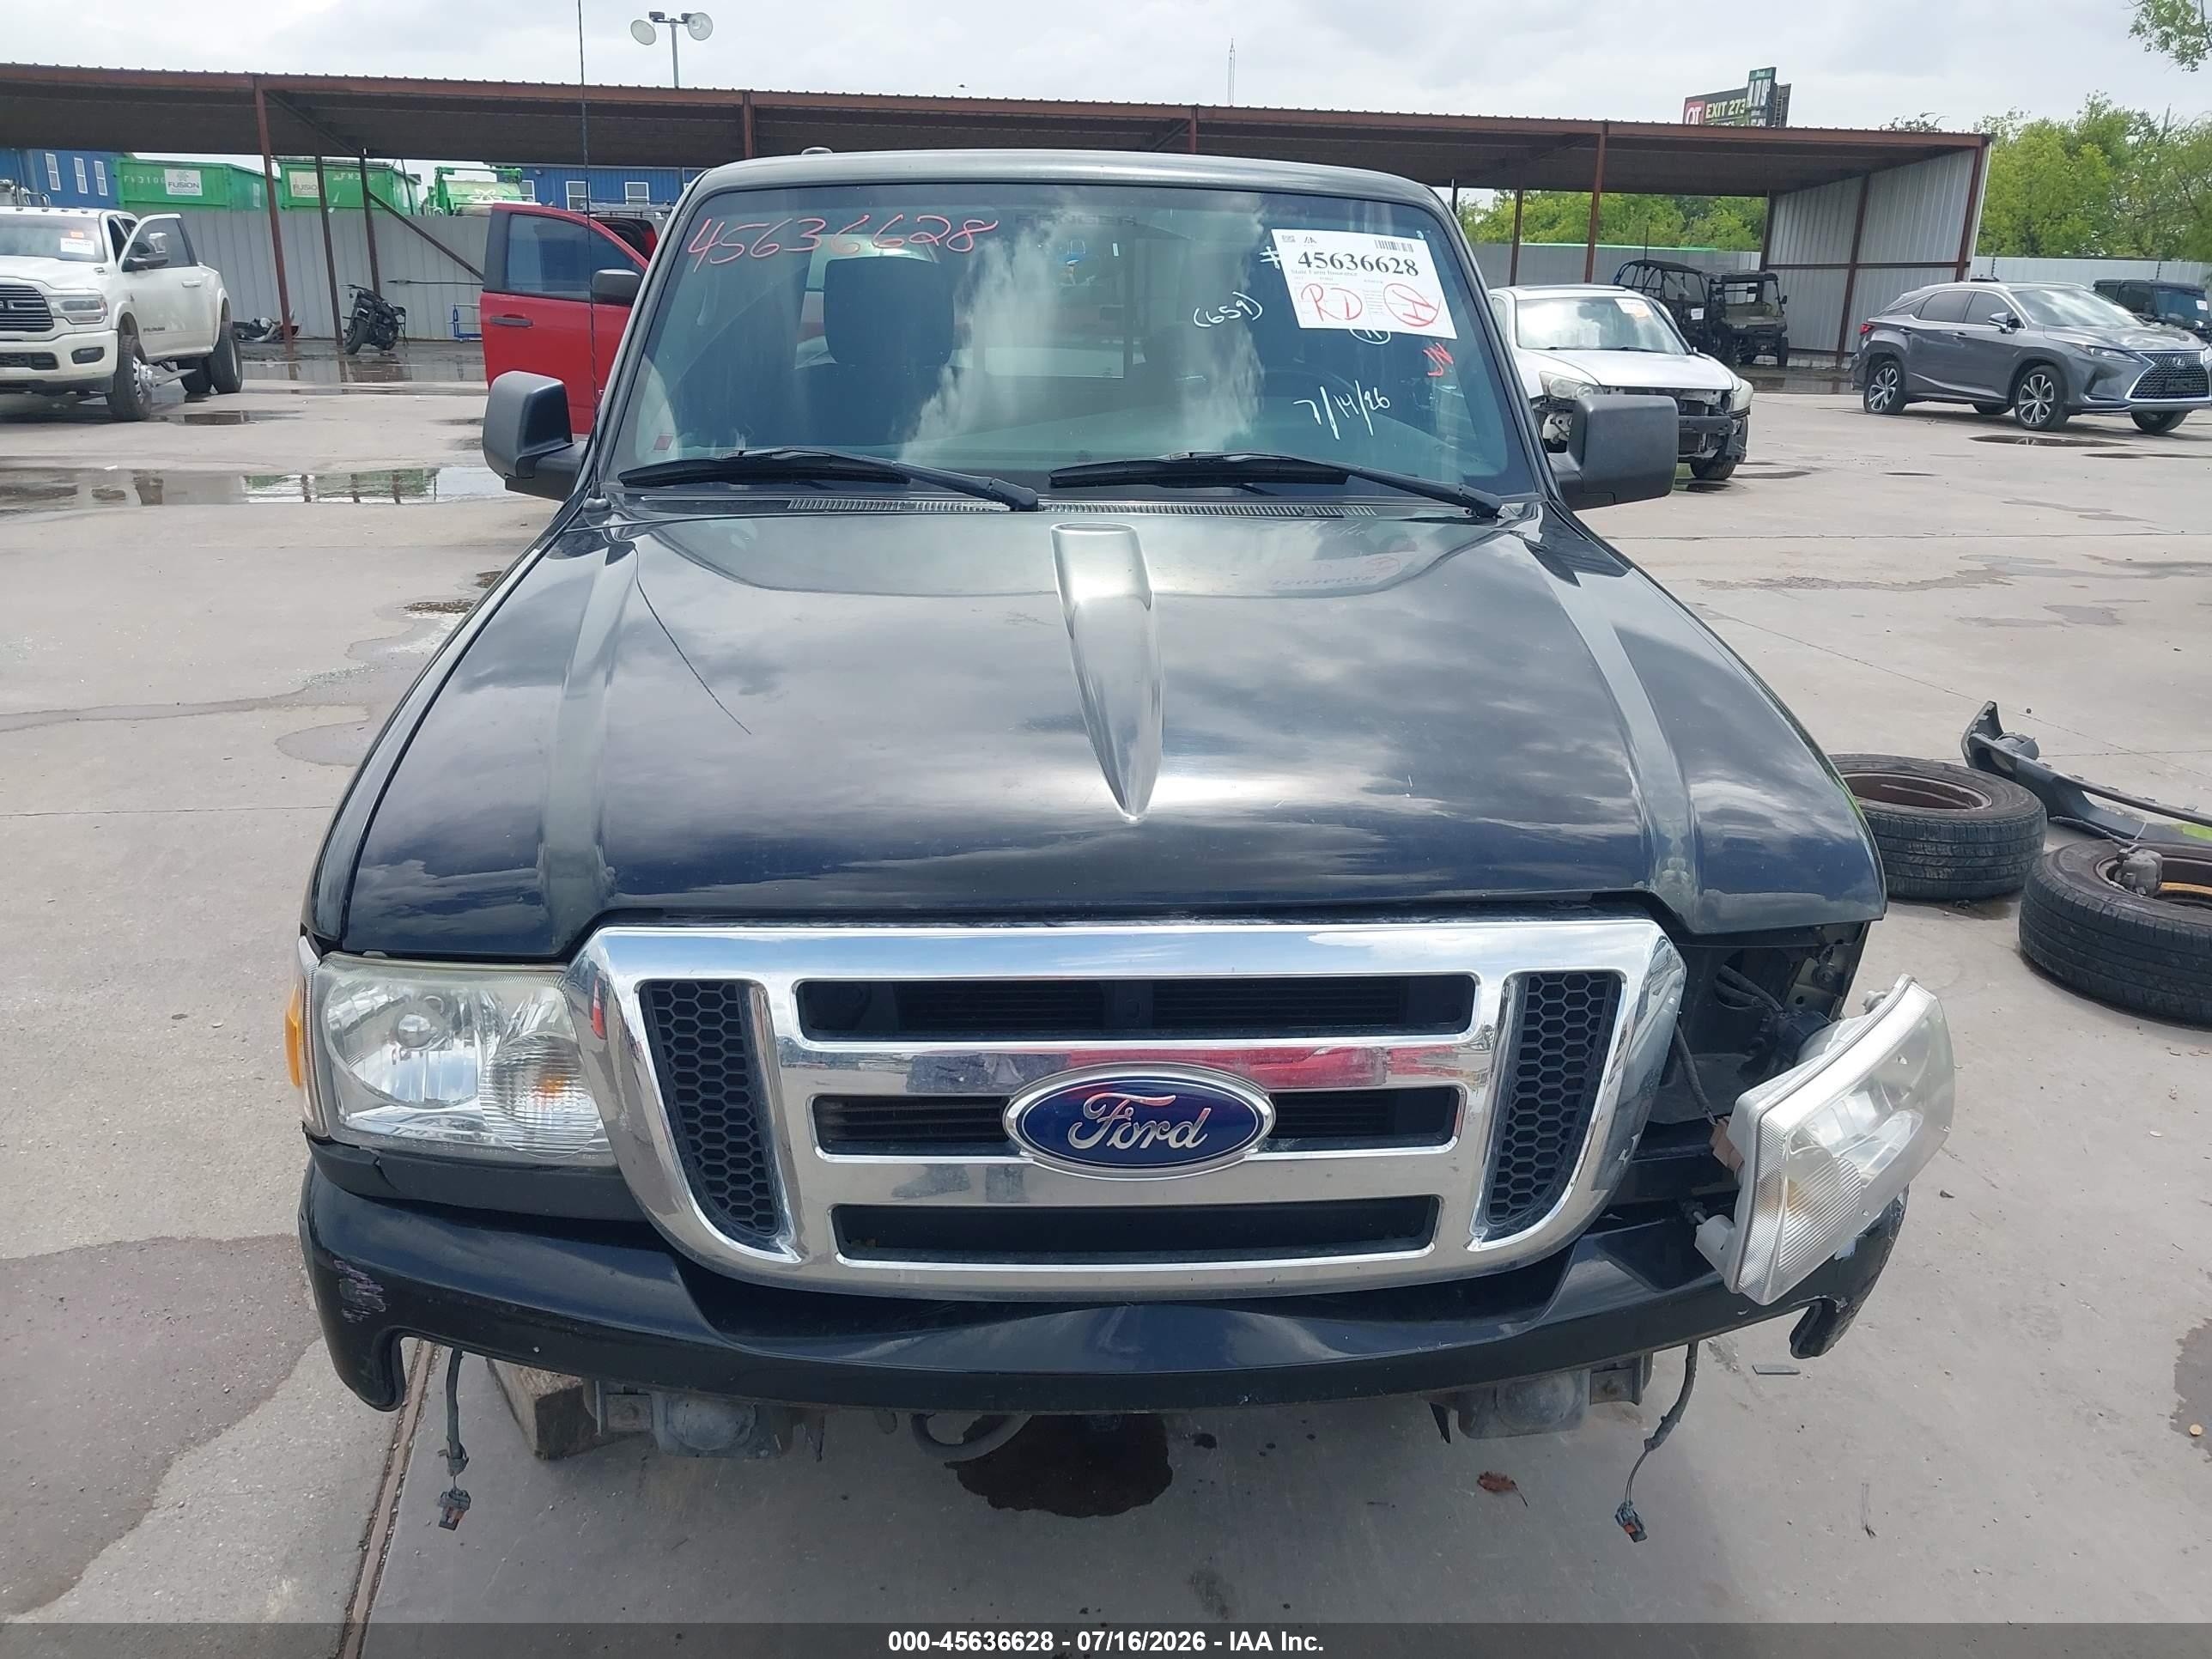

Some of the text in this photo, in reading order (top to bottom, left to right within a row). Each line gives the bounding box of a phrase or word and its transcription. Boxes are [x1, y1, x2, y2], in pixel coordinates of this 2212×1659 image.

[1705, 98, 1747, 118] EXIT 273
[687, 214, 999, 272] 45636628
[1298, 251, 1419, 276] 45636628
[1193, 291, 1263, 328] (659)
[1067, 1092, 1212, 1150] Ford
